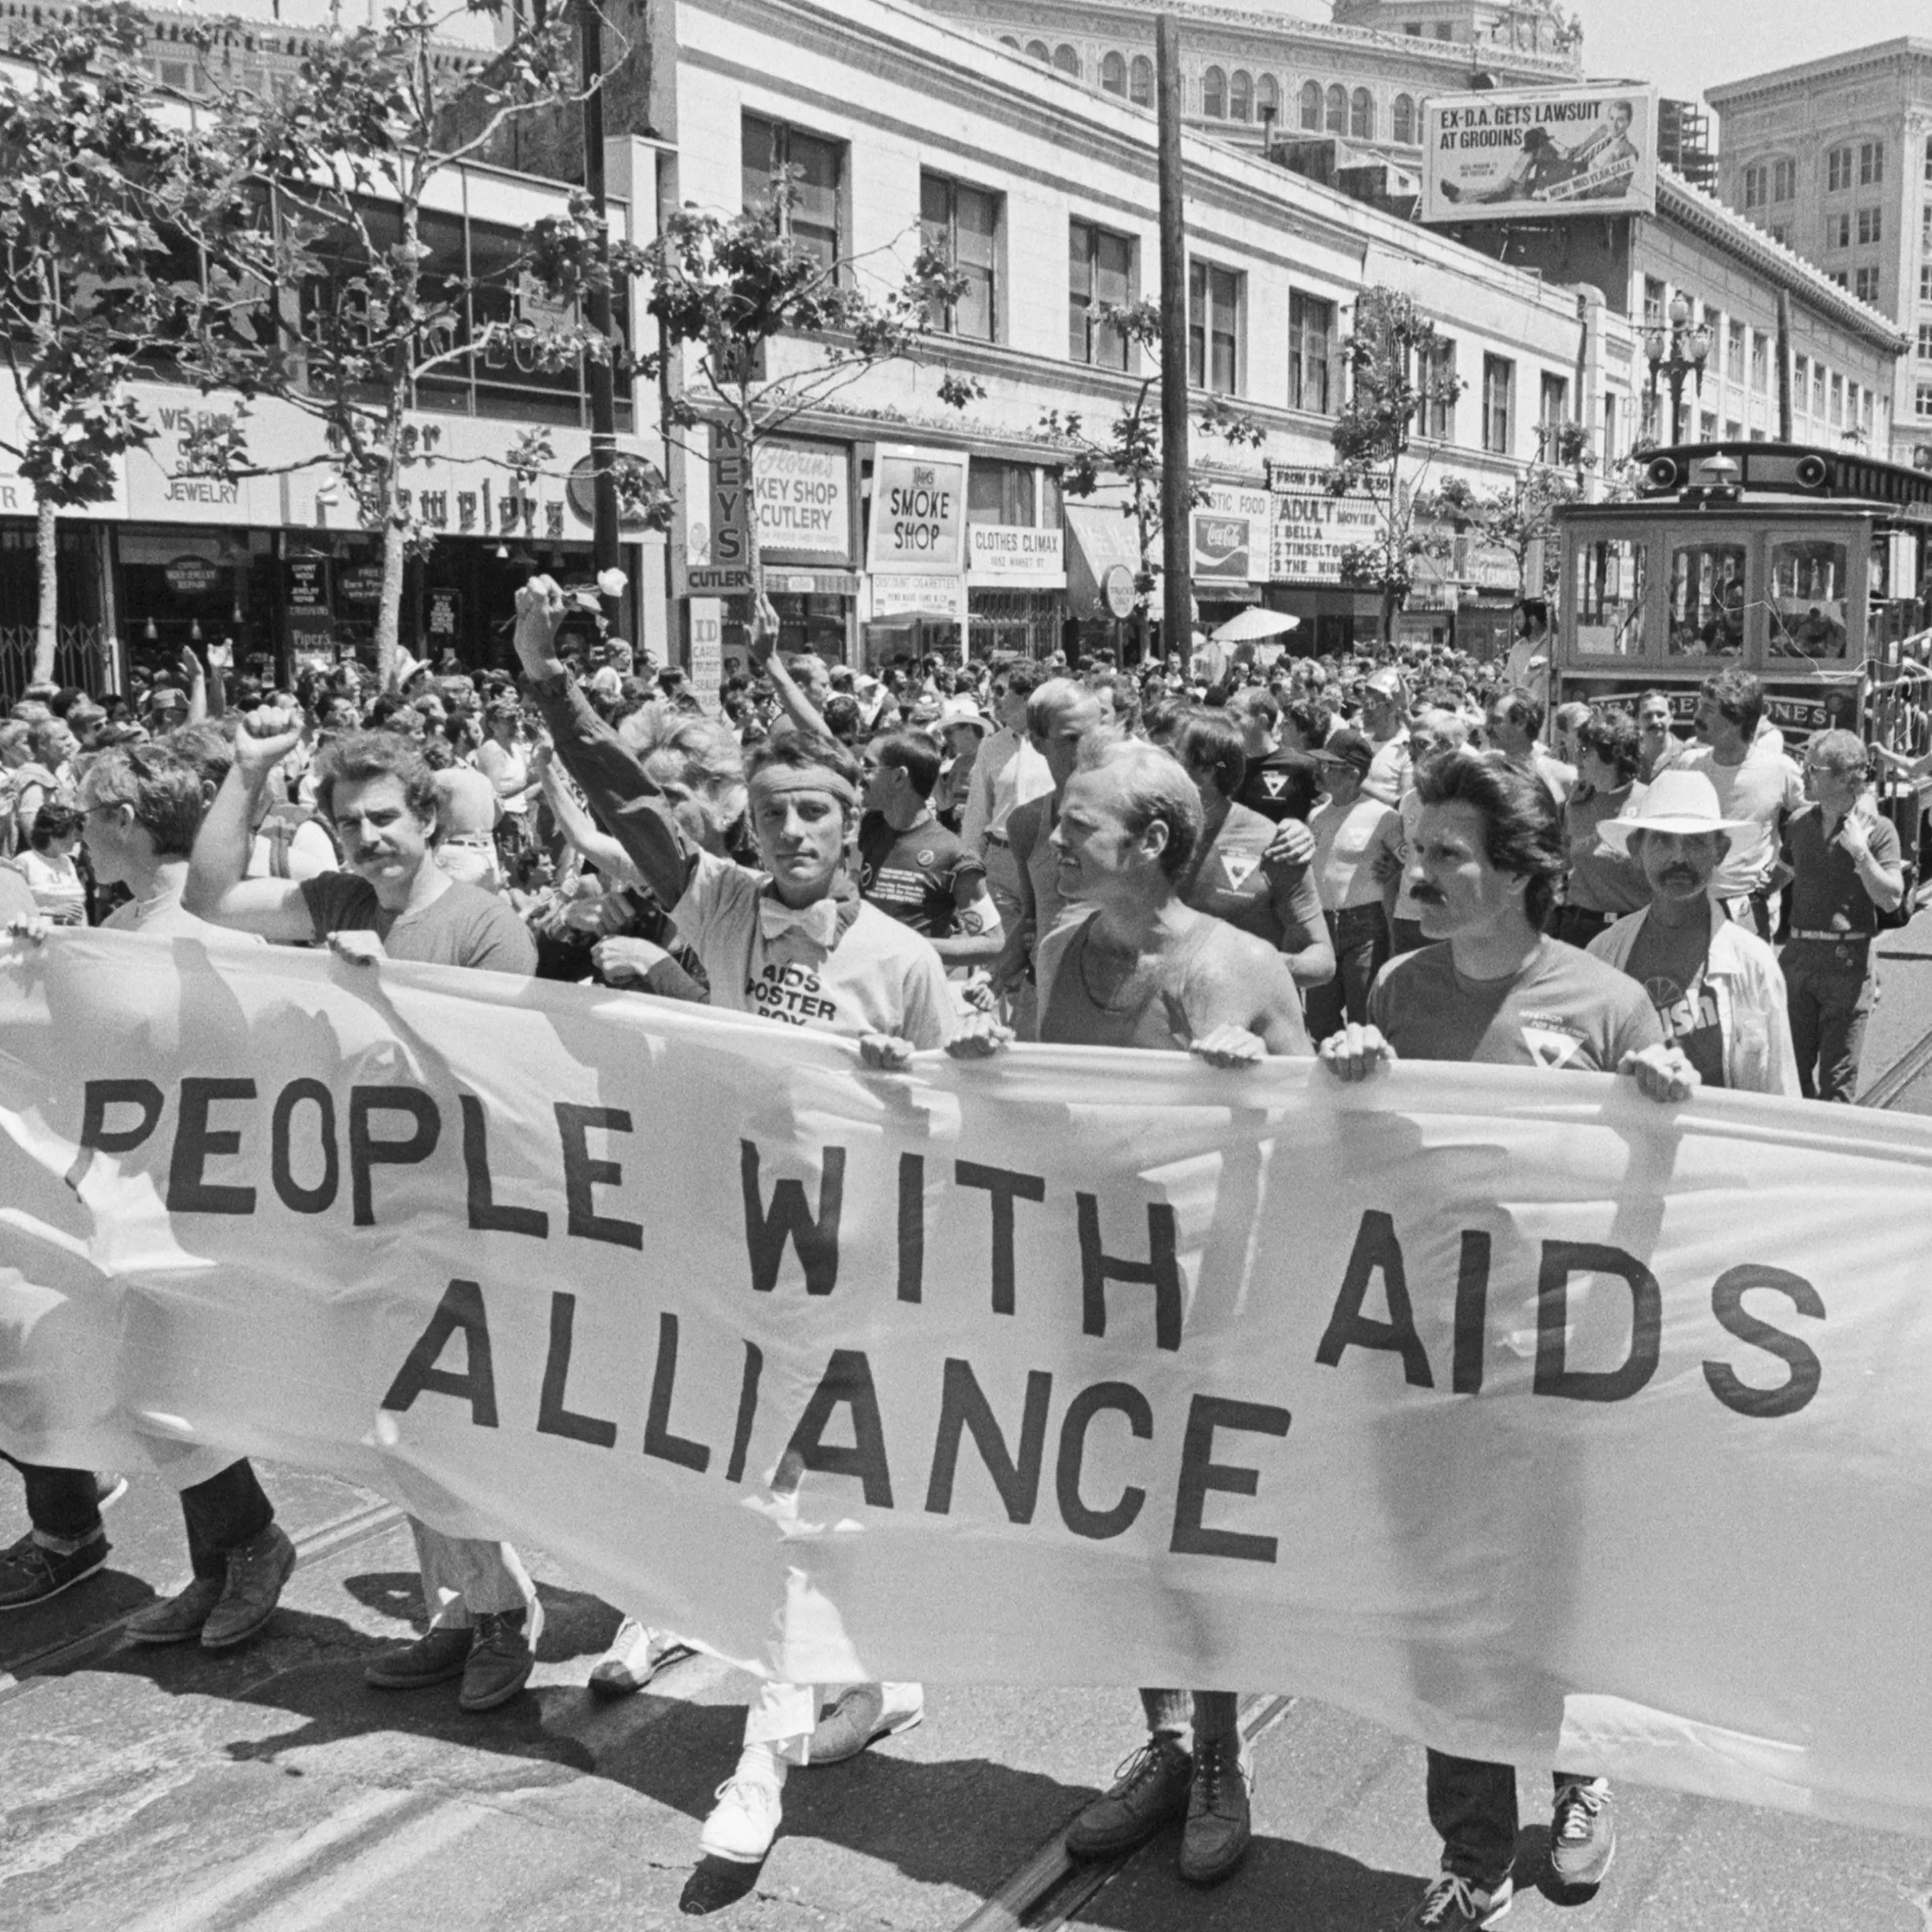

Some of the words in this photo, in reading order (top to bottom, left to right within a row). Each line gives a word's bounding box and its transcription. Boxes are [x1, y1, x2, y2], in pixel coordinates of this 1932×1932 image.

[1441, 109, 1492, 129] EX-D.A.
[1495, 105, 1532, 125] GETS
[1535, 102, 1601, 123] LAWSUIT
[1440, 132, 1458, 149] AT
[1460, 128, 1522, 148] GRODINS
[1610, 159, 1632, 176] SALE
[158, 407, 189, 431] WE
[716, 419, 741, 559] KEYS
[1276, 471, 1306, 485] FROM
[165, 481, 238, 504] JEWELRY
[755, 476, 790, 501] KEY
[793, 480, 838, 506] SHOP
[890, 488, 950, 519] SMOKE
[1240, 495, 1266, 514] FOOD
[1279, 499, 1336, 523] ADULT
[760, 504, 833, 531] CUTLERY
[894, 521, 940, 550] SHOP
[976, 531, 1017, 552] CLOTHES
[1022, 534, 1058, 553] CLIMAX
[1285, 525, 1323, 539] BELLA
[1274, 542, 1281, 556] 2
[1274, 559, 1281, 573] 3
[1285, 559, 1307, 574] THE
[695, 619, 718, 642] ID
[762, 963, 821, 993] AIDS
[64, 1077, 643, 1251] PEOPLE
[740, 1137, 1183, 1352] WITH
[1315, 1209, 1826, 1418] AIDS
[380, 1278, 1292, 1564] ALLIANCE
